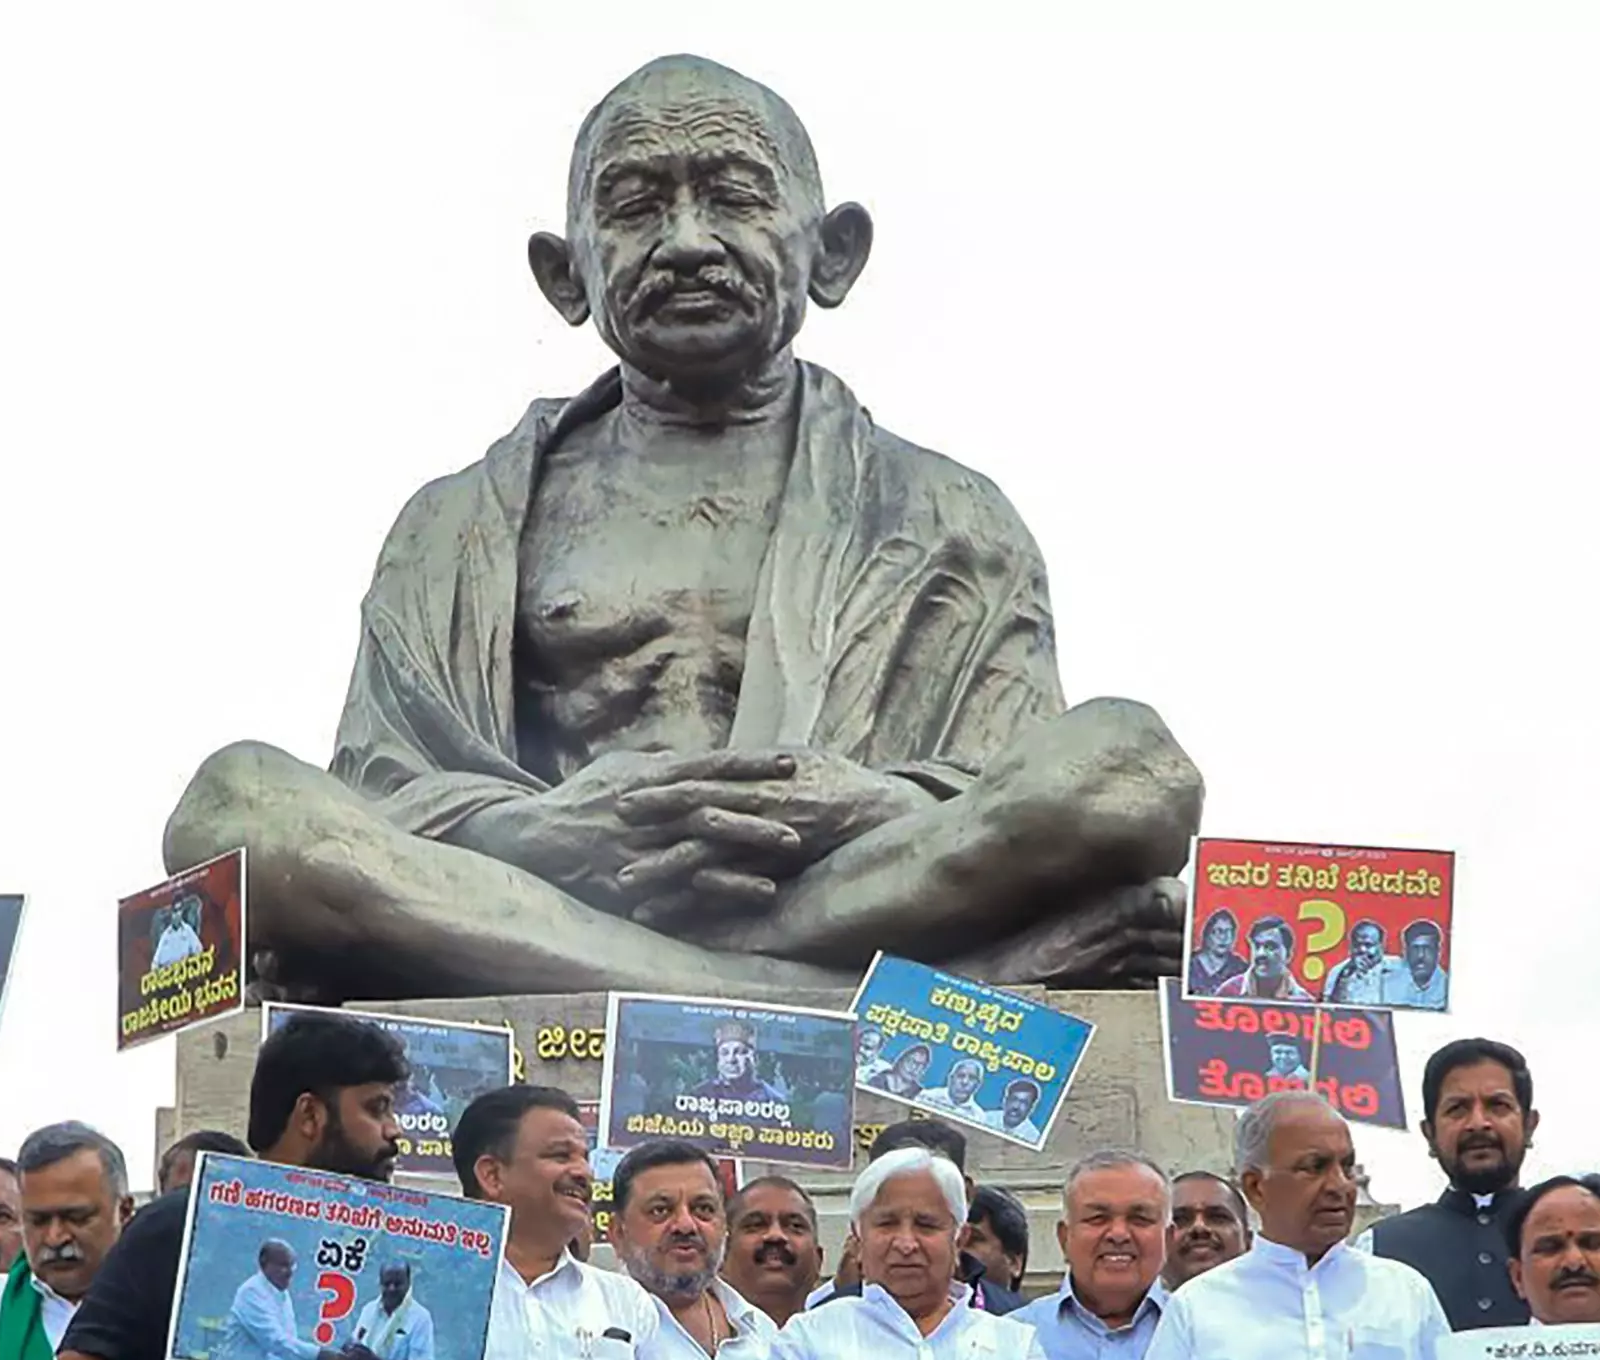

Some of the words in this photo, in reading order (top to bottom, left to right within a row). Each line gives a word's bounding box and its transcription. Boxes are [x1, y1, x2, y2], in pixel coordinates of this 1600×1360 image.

[1206, 861, 1270, 887] ಇವರ
[1276, 863, 1339, 891] ತನಿಖೆ
[1346, 867, 1442, 897] ಬೇಡವೇ
[1297, 899, 1346, 981] ?
[139, 943, 216, 996] ರಾಜಭವನ
[952, 1031, 1056, 1082] ರಾಜ್ಯಪಾಲ
[626, 1114, 703, 1138] ಬಿಜೆಪಿಯ
[710, 1119, 755, 1147] ಆಜ್ಞಾ
[758, 1125, 834, 1150] ಪಾಲಕರು
[675, 1092, 791, 1128] ರಾಜ್ಯಪಾಲರಲ್ಲ
[209, 1179, 241, 1205] ಗಣಿ
[245, 1188, 323, 1220] ಹಗರಣದ
[324, 1199, 383, 1229] ತನಿಖೆಗೆ
[386, 1214, 459, 1243] ಅನುಮತಿ
[461, 1226, 492, 1258] ಇಲ್ಲ
[316, 1237, 368, 1271] ಏಕೆ
[315, 1272, 356, 1345] ?
